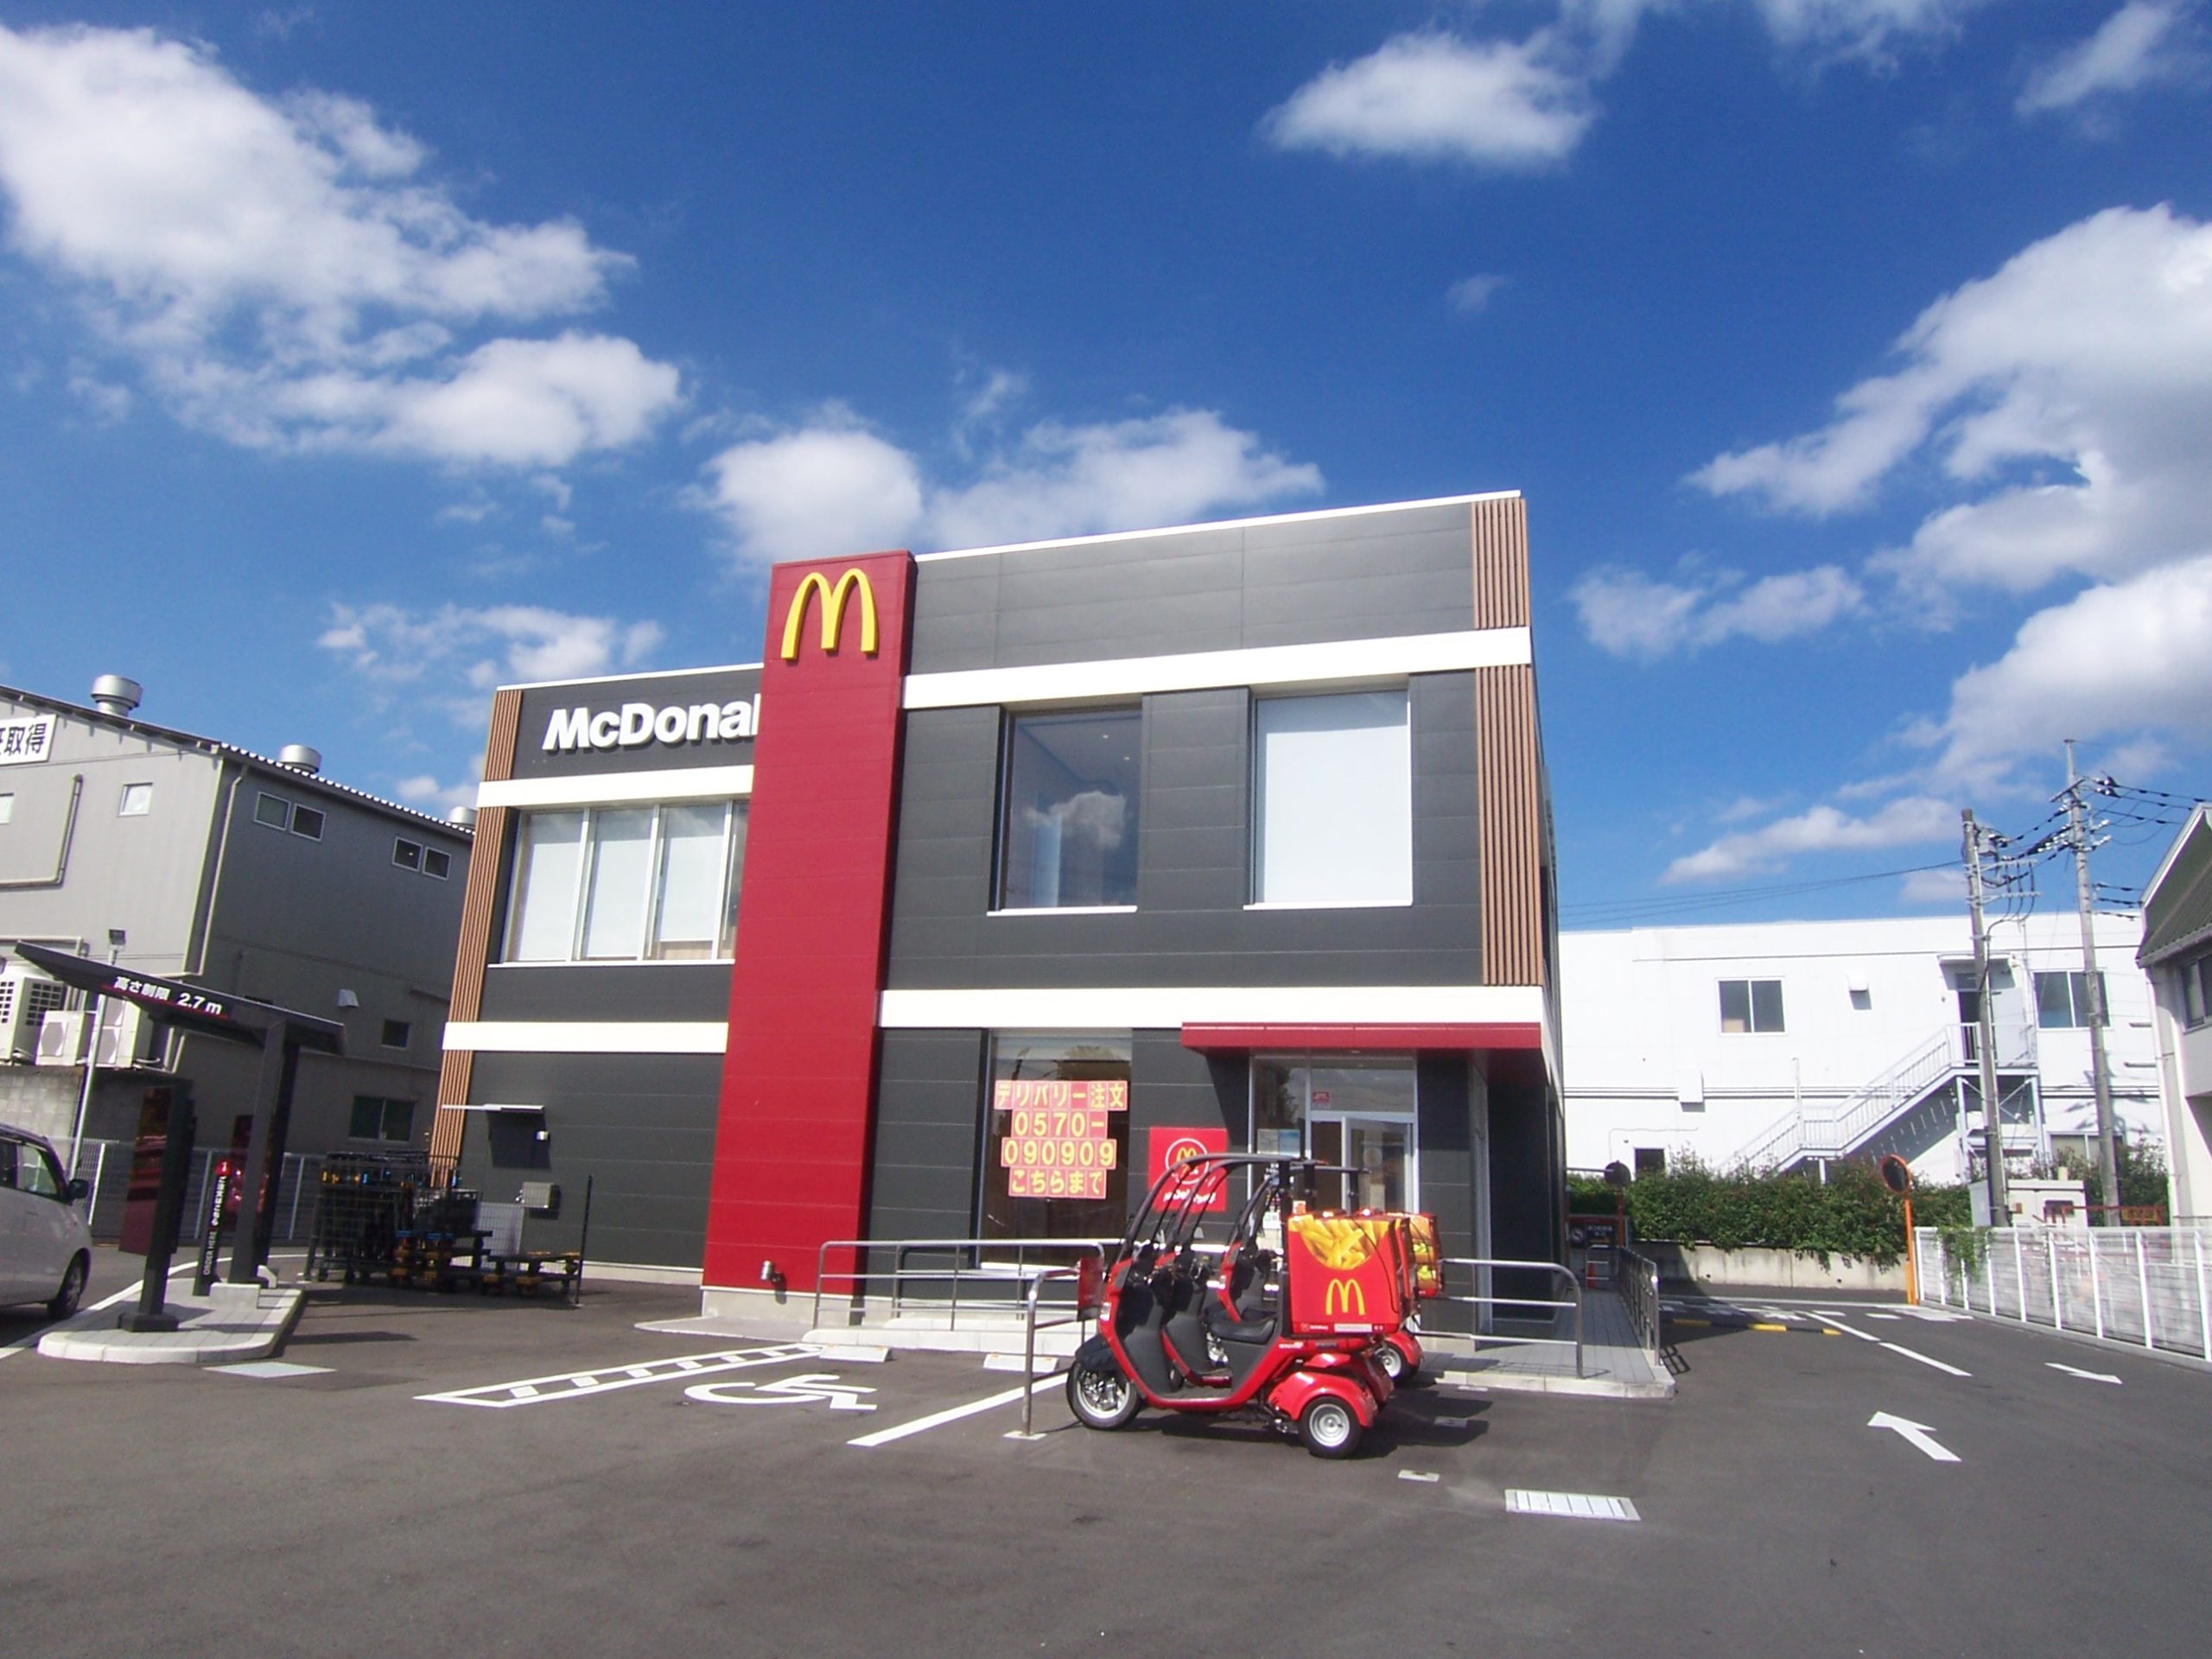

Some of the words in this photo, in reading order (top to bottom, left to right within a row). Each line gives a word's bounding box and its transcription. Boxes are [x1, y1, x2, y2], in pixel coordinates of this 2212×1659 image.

[542, 692, 760, 751] McDonal
[997, 1084, 1124, 1109] デリバリー注文
[1004, 1140, 1114, 1166] 090909
[1012, 1169, 1103, 1195] こちらまで
